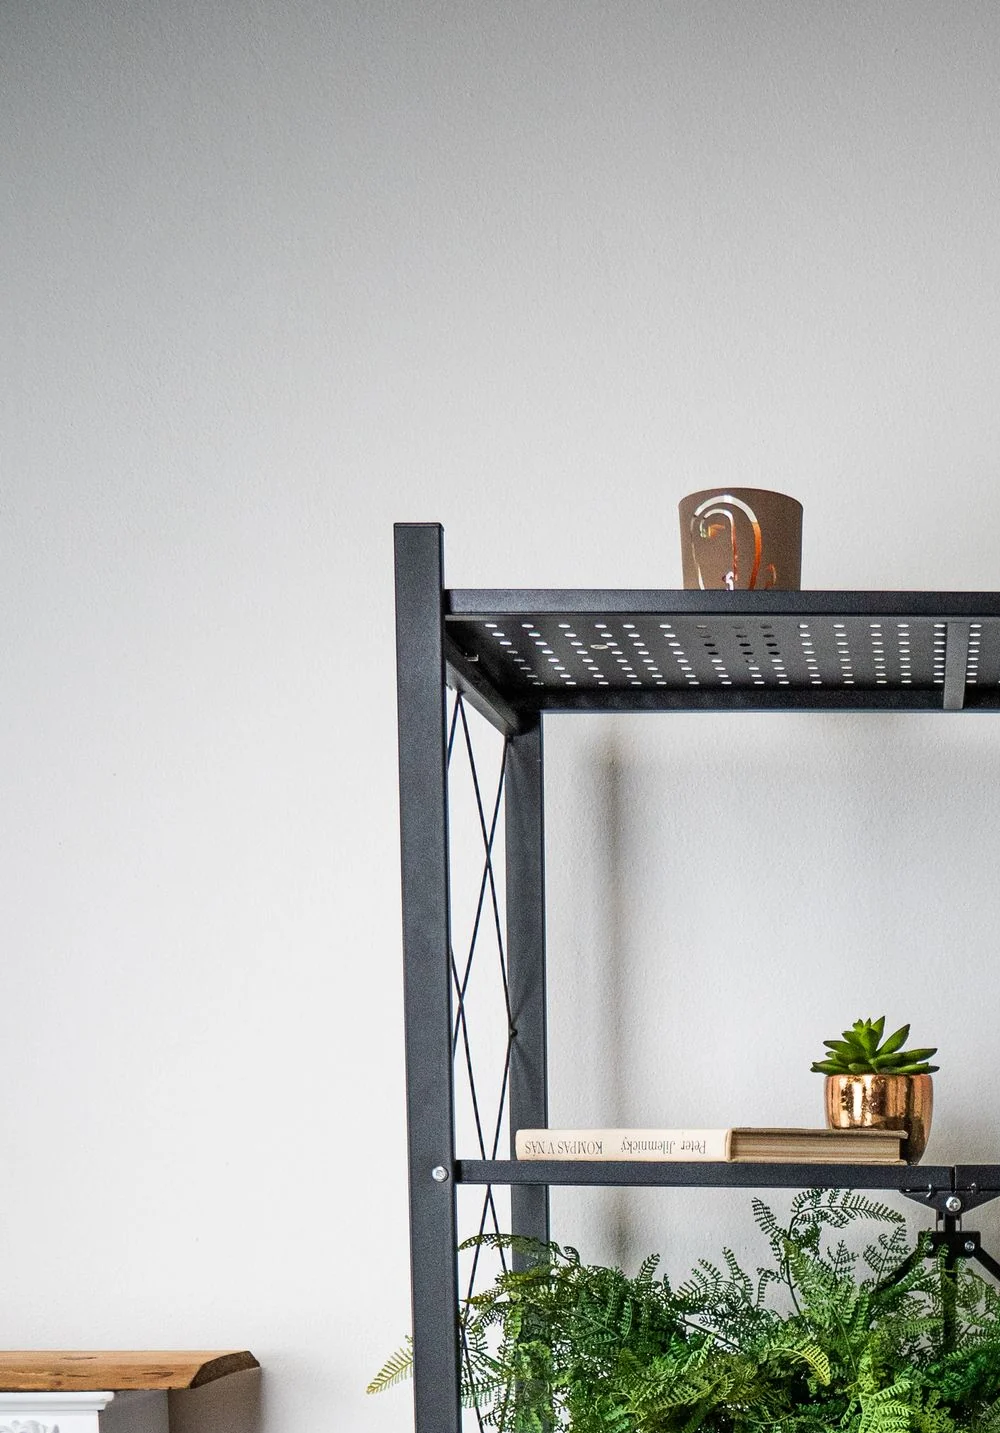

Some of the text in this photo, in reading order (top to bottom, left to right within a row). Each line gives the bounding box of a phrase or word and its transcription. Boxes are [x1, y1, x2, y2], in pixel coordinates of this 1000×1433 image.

[525, 1140, 603, 1156] KOMPAS V NÁS
[621, 1136, 706, 1155] Peter Jilemnický
